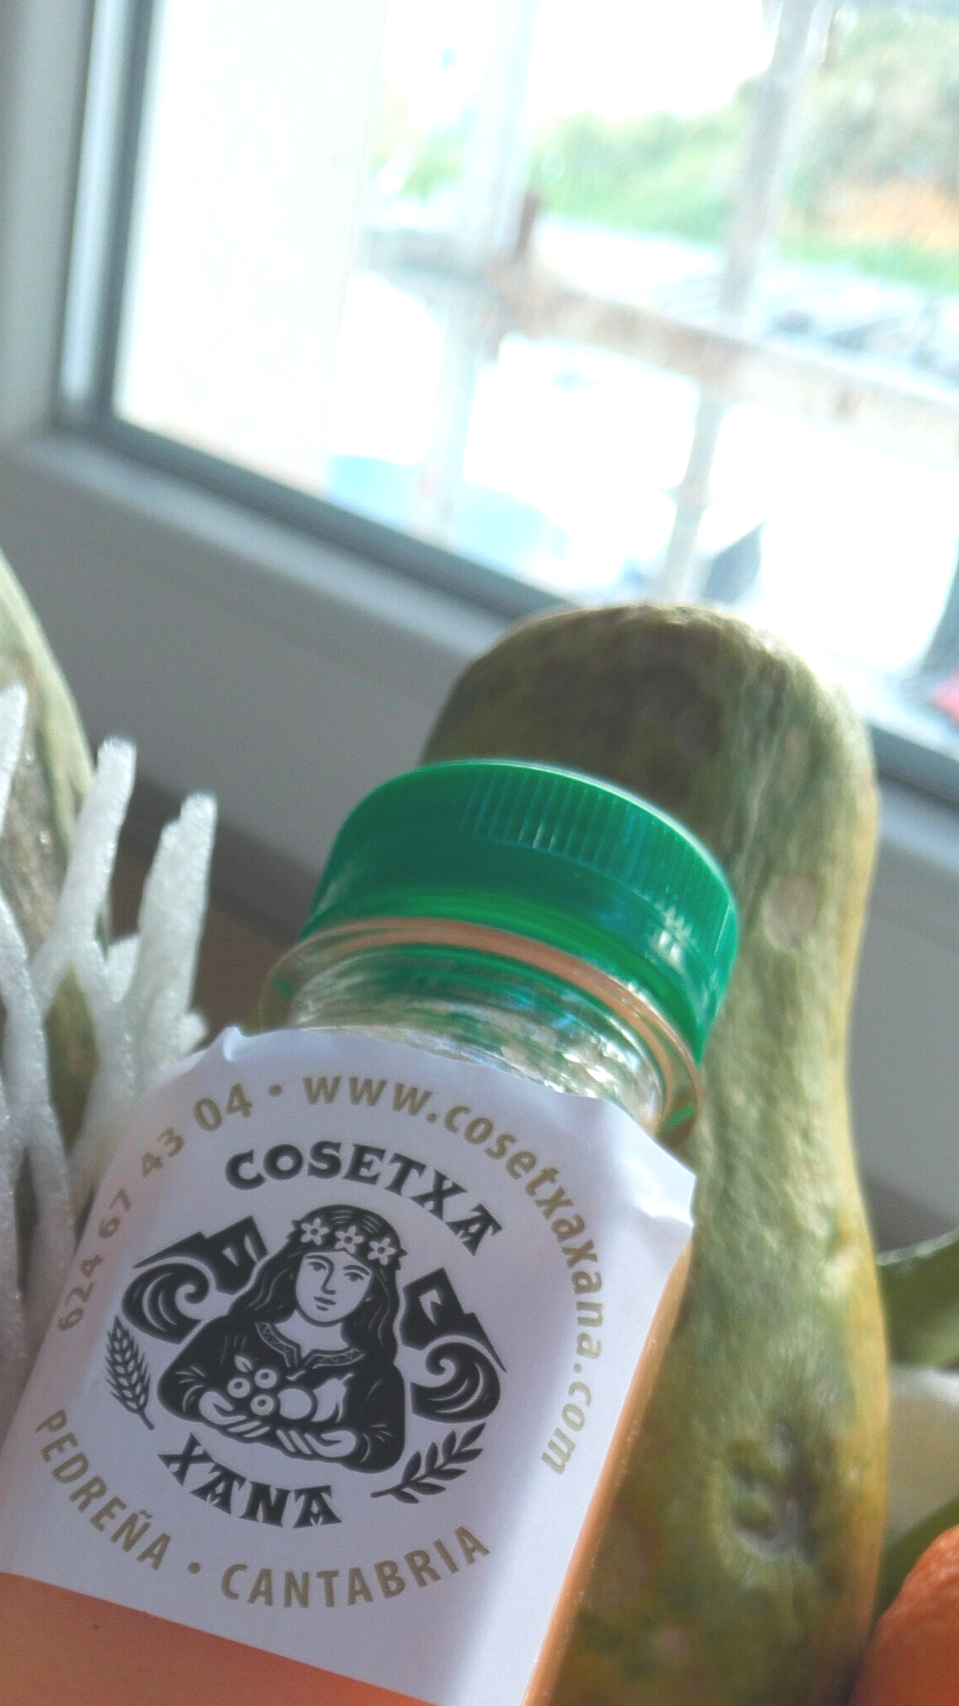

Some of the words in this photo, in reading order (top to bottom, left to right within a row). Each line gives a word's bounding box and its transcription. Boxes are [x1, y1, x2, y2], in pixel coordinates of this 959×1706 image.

[58, 1255, 103, 1332] 624
[97, 1188, 132, 1239] 67
[140, 1127, 185, 1178] 43
[193, 1082, 253, 1132] 04
[304, 1075, 610, 1476] www.cosetxaxana.com
[225, 1139, 503, 1256] COSETXA
[35, 1409, 171, 1572] PEDREÑA
[221, 1525, 490, 1608] CANTABRIA
[158, 1432, 342, 1528] XANA
